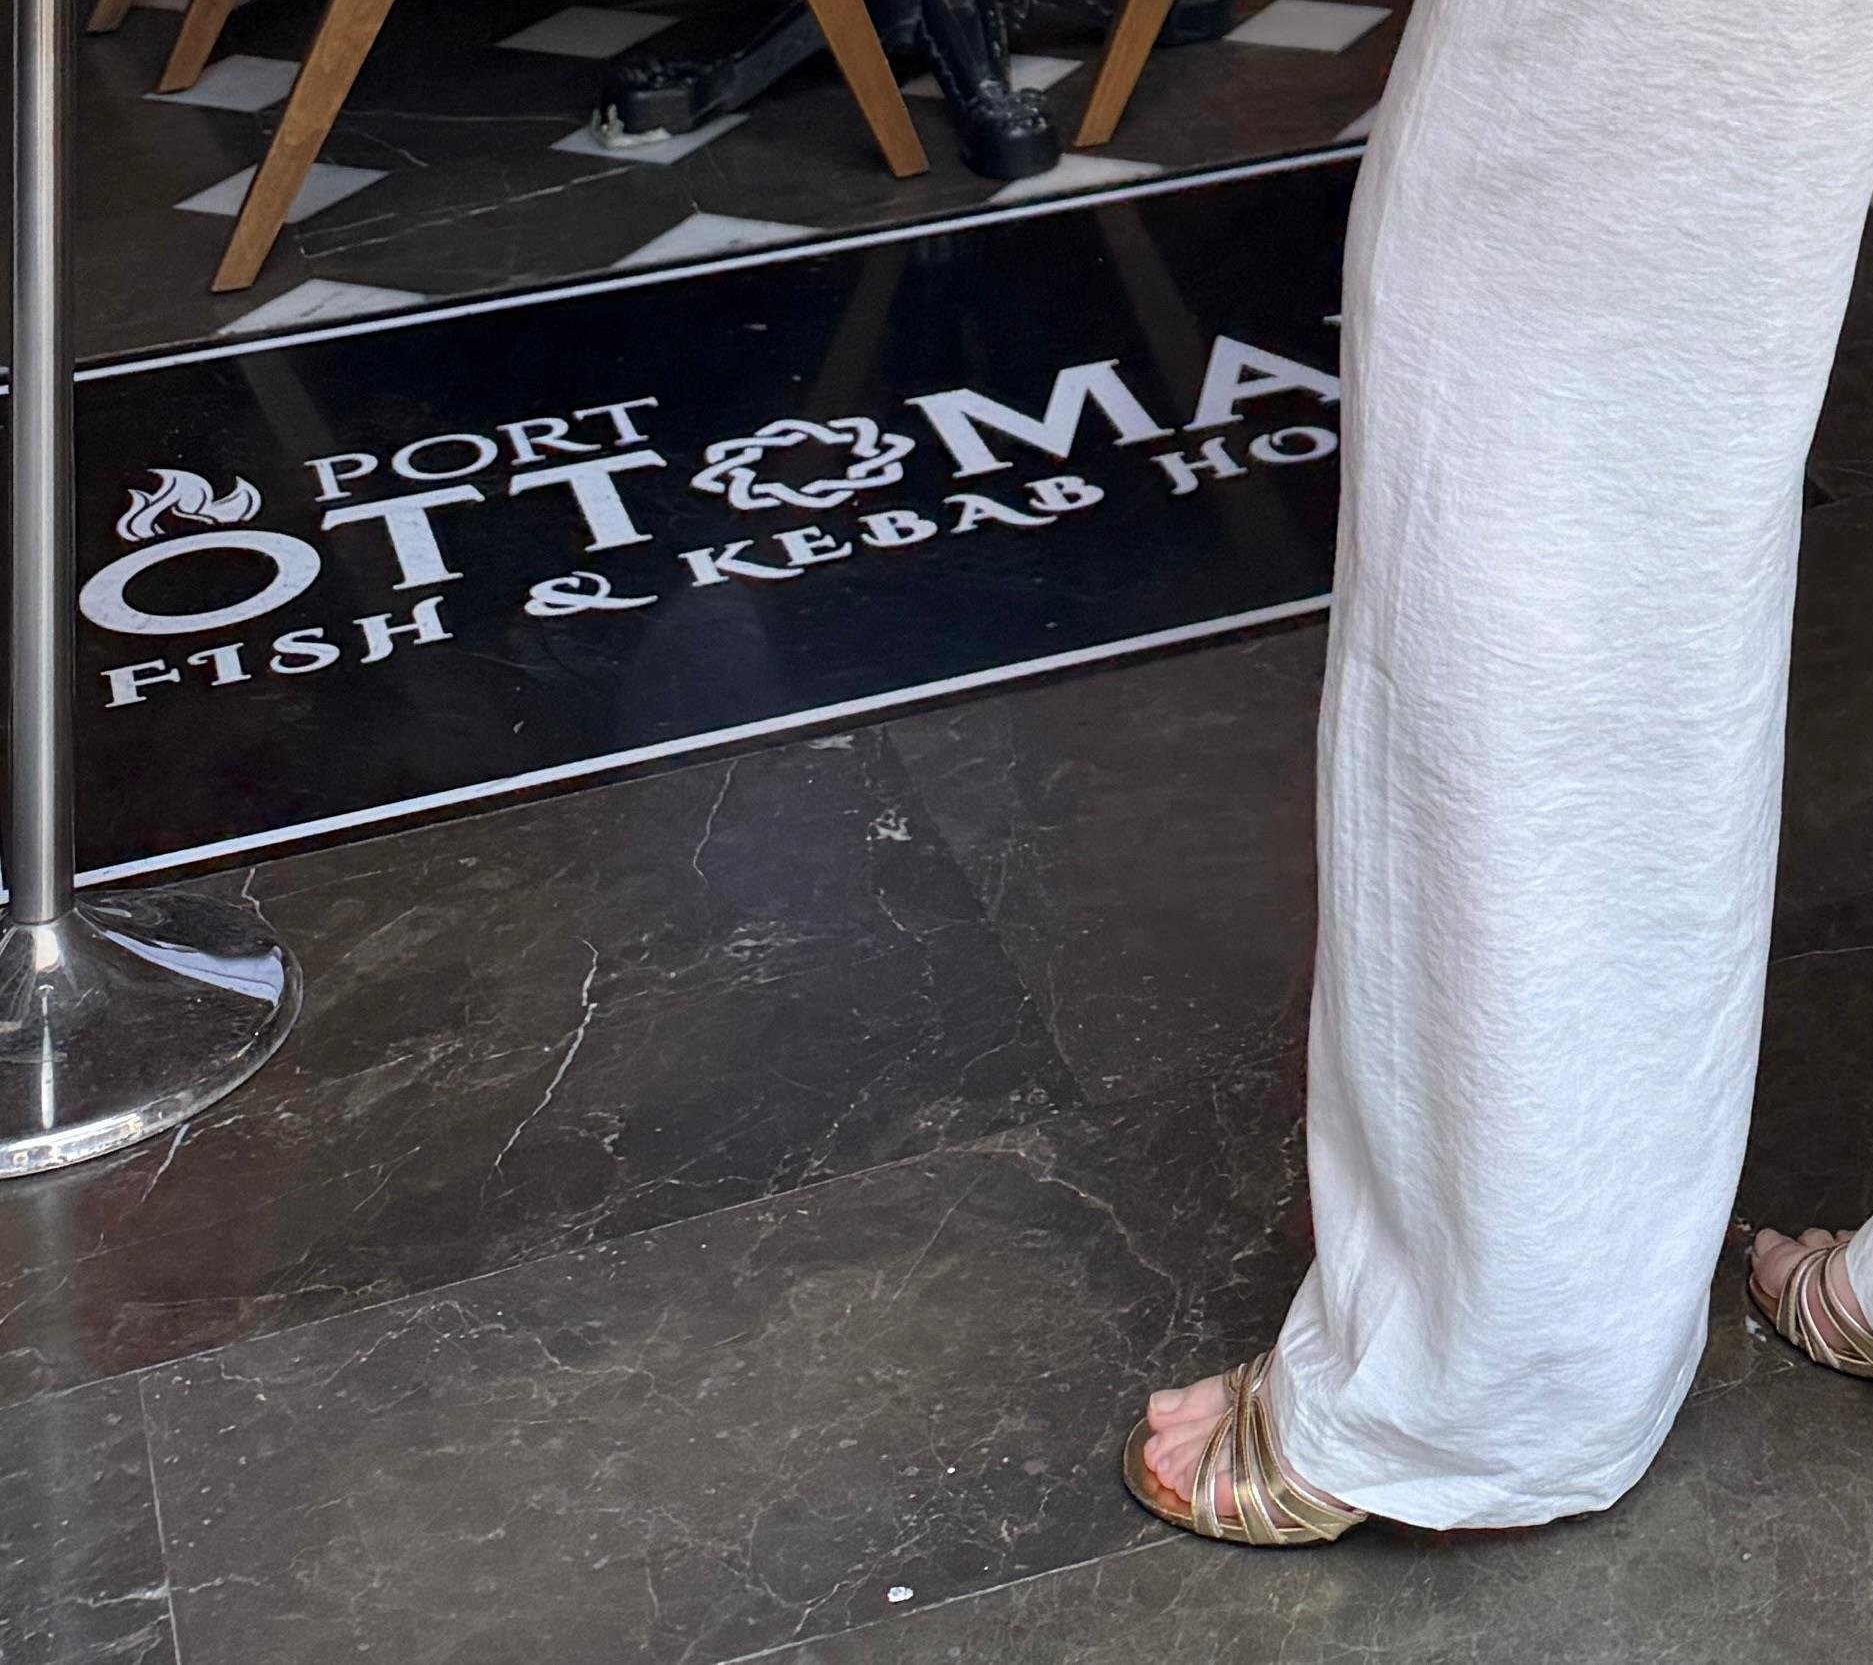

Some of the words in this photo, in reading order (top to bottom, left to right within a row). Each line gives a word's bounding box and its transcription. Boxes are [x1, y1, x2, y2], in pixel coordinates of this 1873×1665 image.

[304, 396, 658, 502] PORT
[100, 595, 454, 708] FISH
[524, 571, 658, 616] &
[678, 476, 1105, 587] KEBAB
